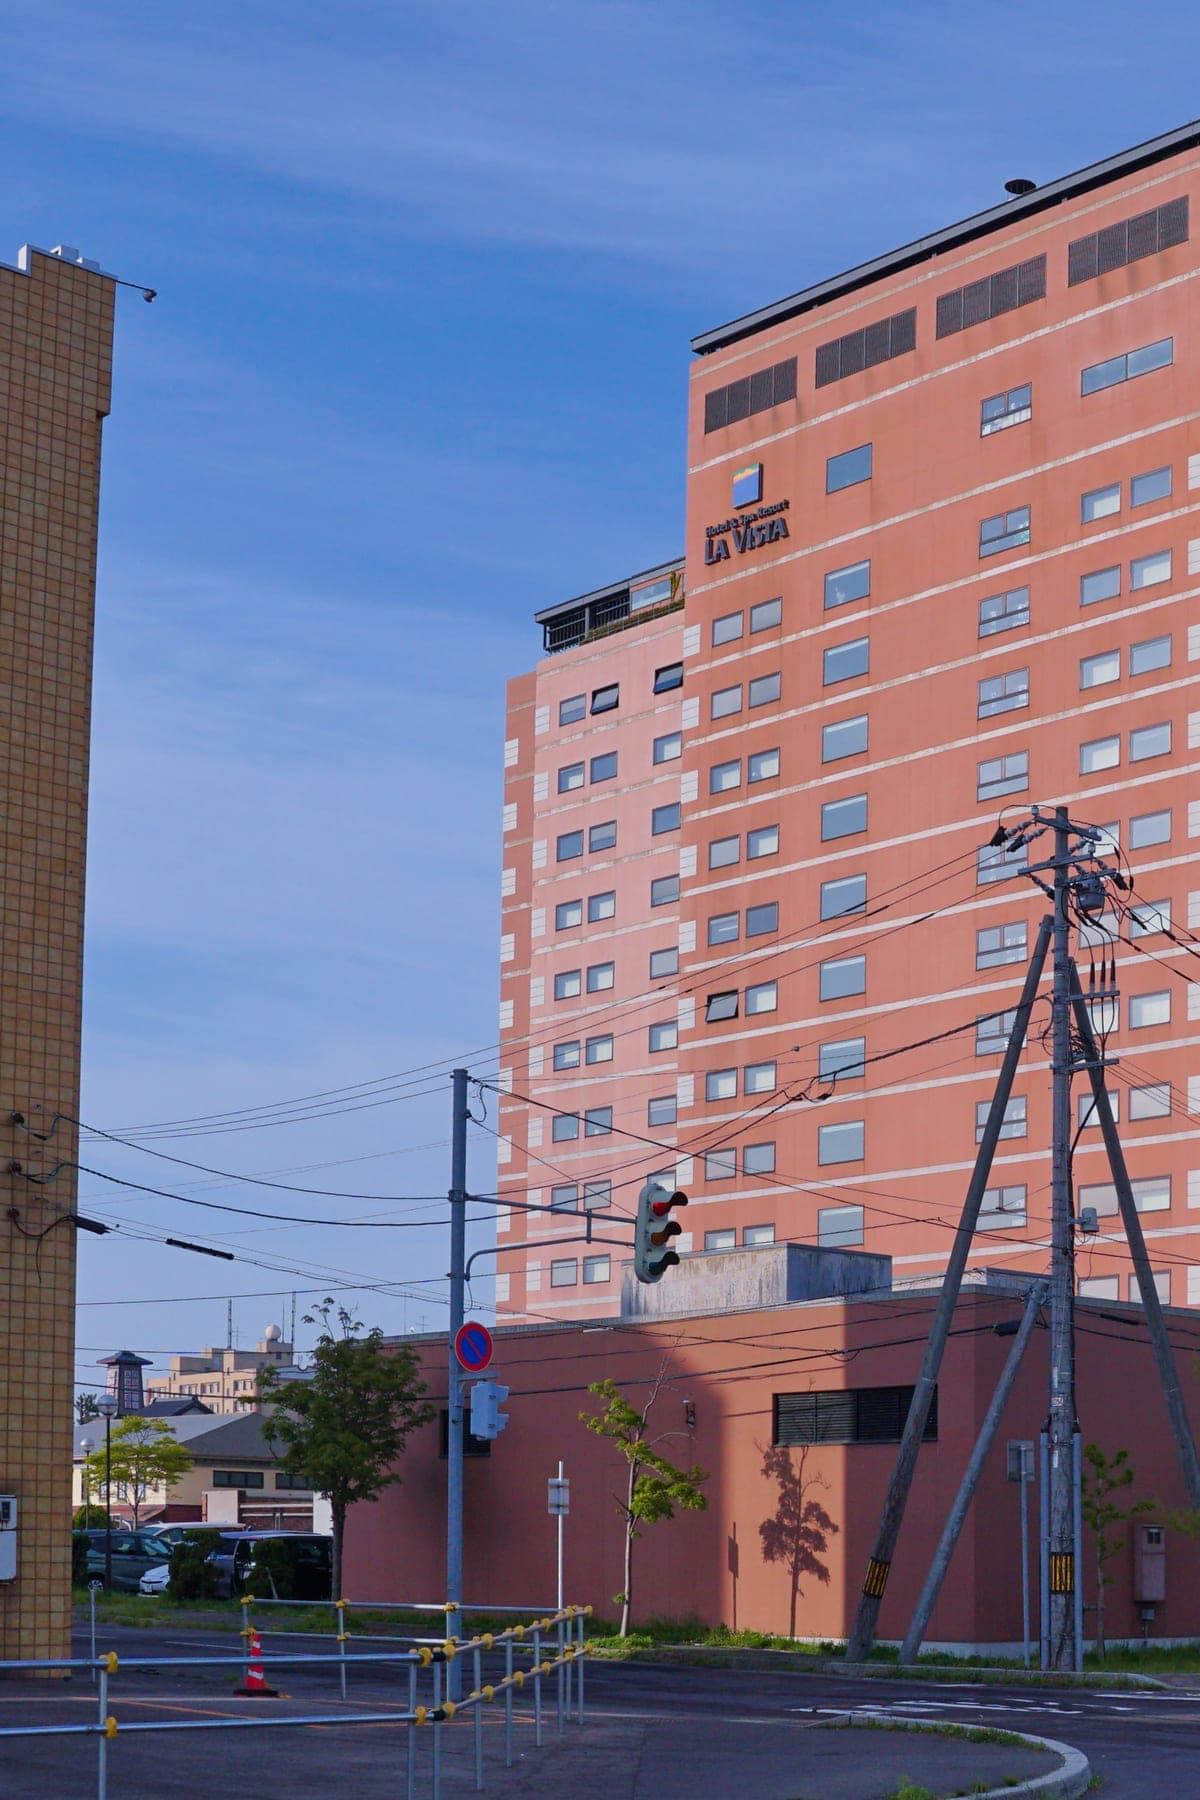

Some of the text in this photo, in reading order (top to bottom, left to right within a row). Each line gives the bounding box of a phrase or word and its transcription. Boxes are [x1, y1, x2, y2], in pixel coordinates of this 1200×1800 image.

[705, 520, 731, 537] Hotel
[757, 499, 790, 518] Resort
[704, 517, 790, 566] LA VISTA
